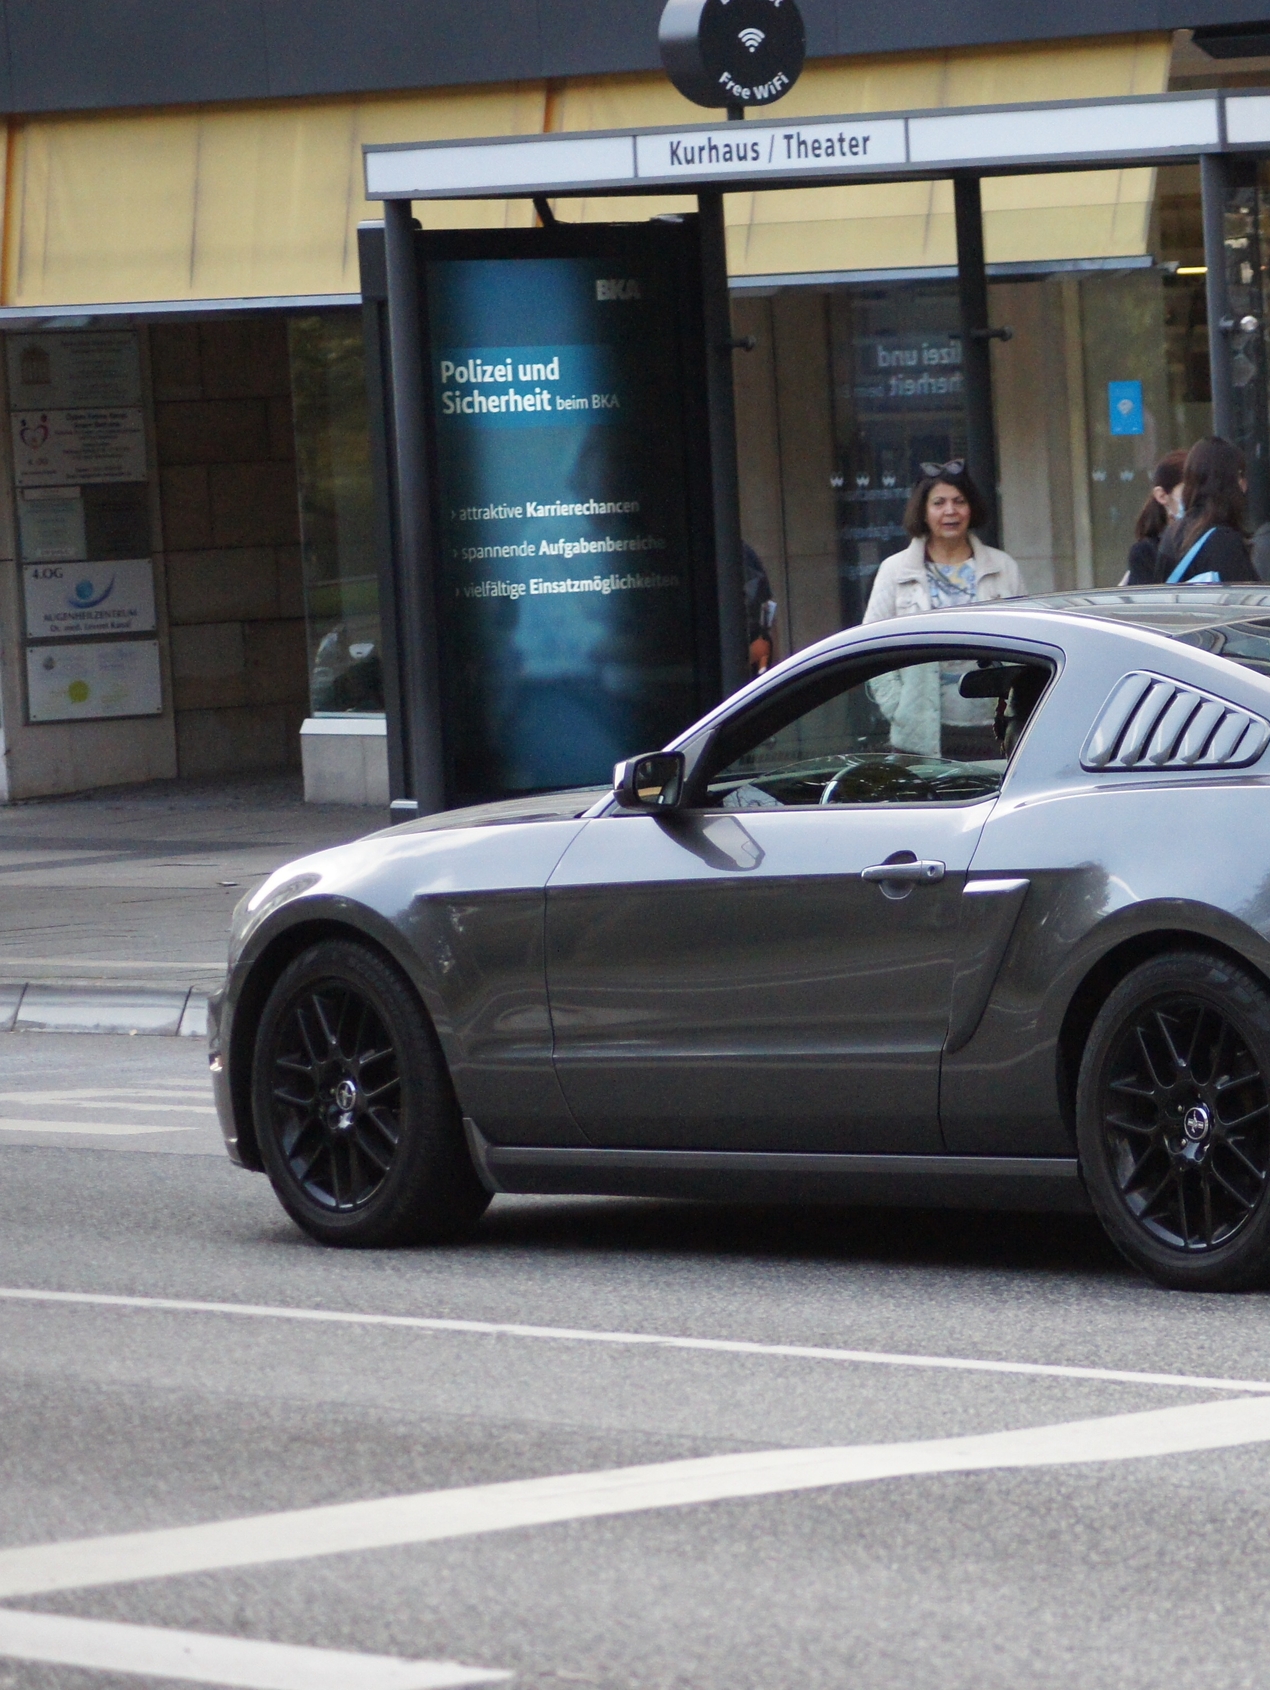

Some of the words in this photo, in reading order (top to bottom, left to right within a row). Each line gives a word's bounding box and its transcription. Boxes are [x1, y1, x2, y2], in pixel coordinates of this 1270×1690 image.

[718, 71, 750, 100] Free
[752, 71, 790, 100] WiFi
[669, 136, 760, 166] Kurhaus
[783, 131, 871, 160] Theater
[596, 279, 641, 301] BKA
[440, 358, 513, 384] Polizei
[518, 356, 560, 381] und
[442, 387, 552, 415] Sicherheit
[556, 394, 589, 411] beim
[591, 394, 621, 410] BKA
[459, 503, 523, 521] attraktive
[526, 499, 640, 518] Karrierechancen
[461, 540, 536, 562] spannende
[538, 535, 667, 558] Aufgabenbereiche
[464, 579, 527, 600] vielfältige
[529, 573, 679, 595] Einsatzmöglichkeiten
